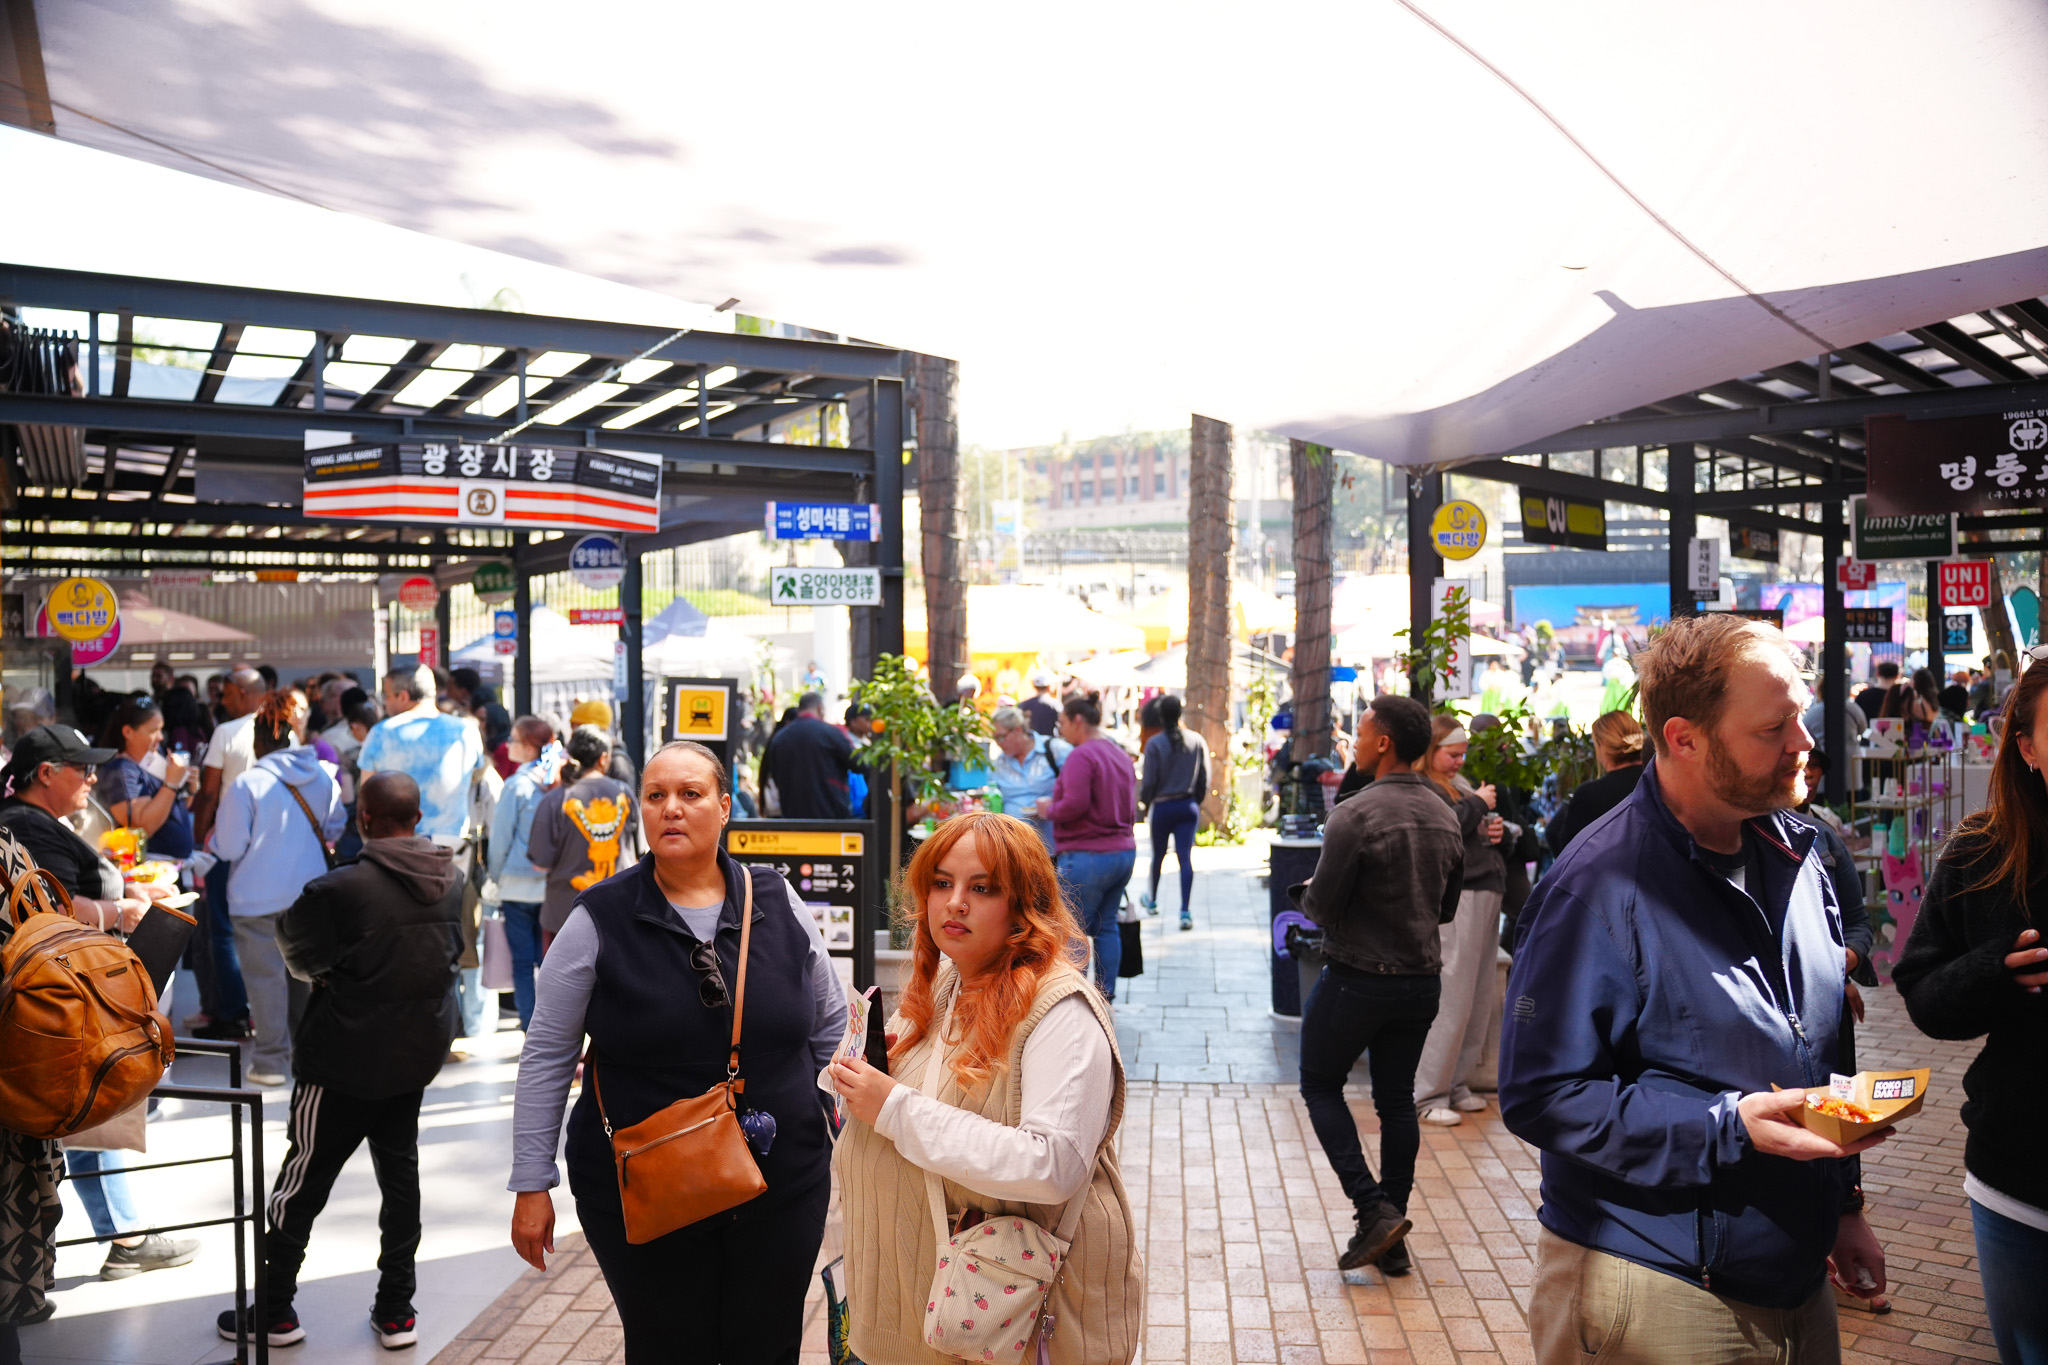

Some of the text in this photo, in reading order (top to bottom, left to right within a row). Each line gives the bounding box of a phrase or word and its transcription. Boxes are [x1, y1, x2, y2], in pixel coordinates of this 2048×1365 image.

[2003, 410, 2034, 420] 1966년
[336, 451, 353, 464] JANG
[354, 447, 383, 461] MARKET
[422, 443, 556, 481] 광장시장
[632, 468, 657, 482] MARKET
[1939, 452, 2048, 491] 명동
[797, 507, 850, 531] 성미식품
[1547, 496, 1566, 534] CU
[1863, 513, 1946, 531] innisfree
[1437, 531, 1481, 548] 빽다방
[1847, 563, 1867, 585] 약
[1944, 566, 1982, 585] UNI
[800, 573, 858, 600] 올영양행
[1945, 585, 1985, 605] QLO
[56, 609, 109, 627] 빽다방
[1945, 615, 1968, 631] GS
[1947, 630, 1968, 645] 25
[1872, 1090, 1894, 1099] DAK
[1874, 1080, 1902, 1091] KOKO
